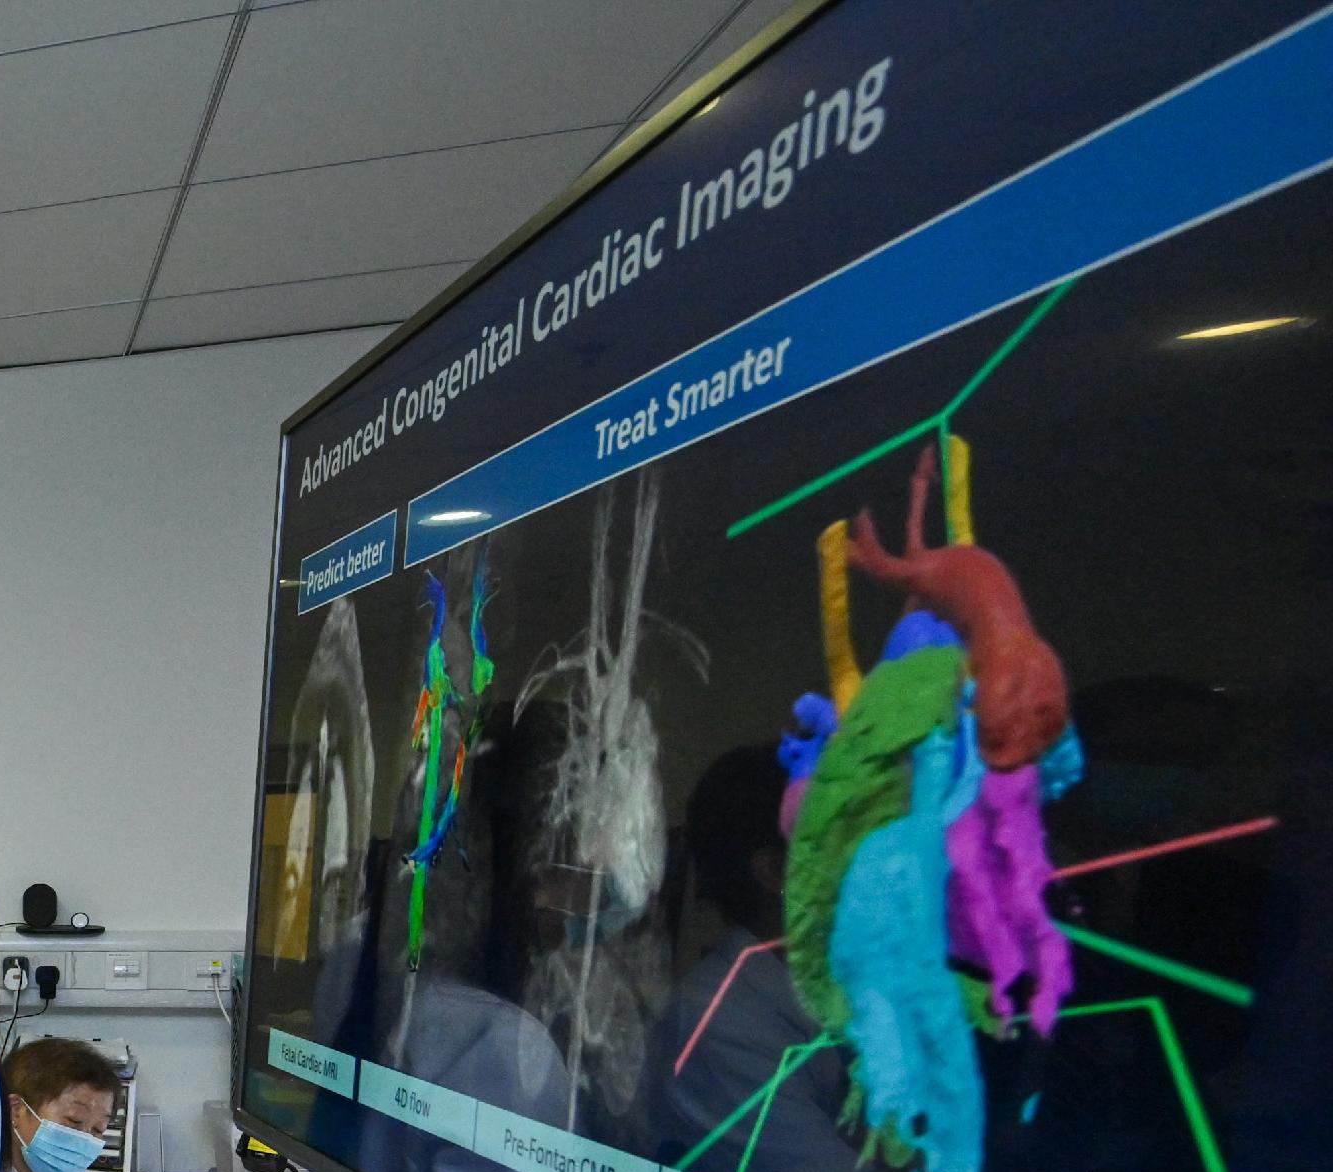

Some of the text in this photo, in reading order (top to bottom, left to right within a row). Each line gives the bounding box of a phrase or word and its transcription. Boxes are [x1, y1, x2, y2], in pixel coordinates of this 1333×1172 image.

[300, 57, 893, 498] Advanced Congenital Cardiac Imaging
[595, 336, 792, 460] Treat Smarter
[306, 540, 386, 596] Predict better
[297, 1048, 323, 1075] Cardiac
[323, 1061, 338, 1081] MRI
[394, 1086, 431, 1118] 4D flow
